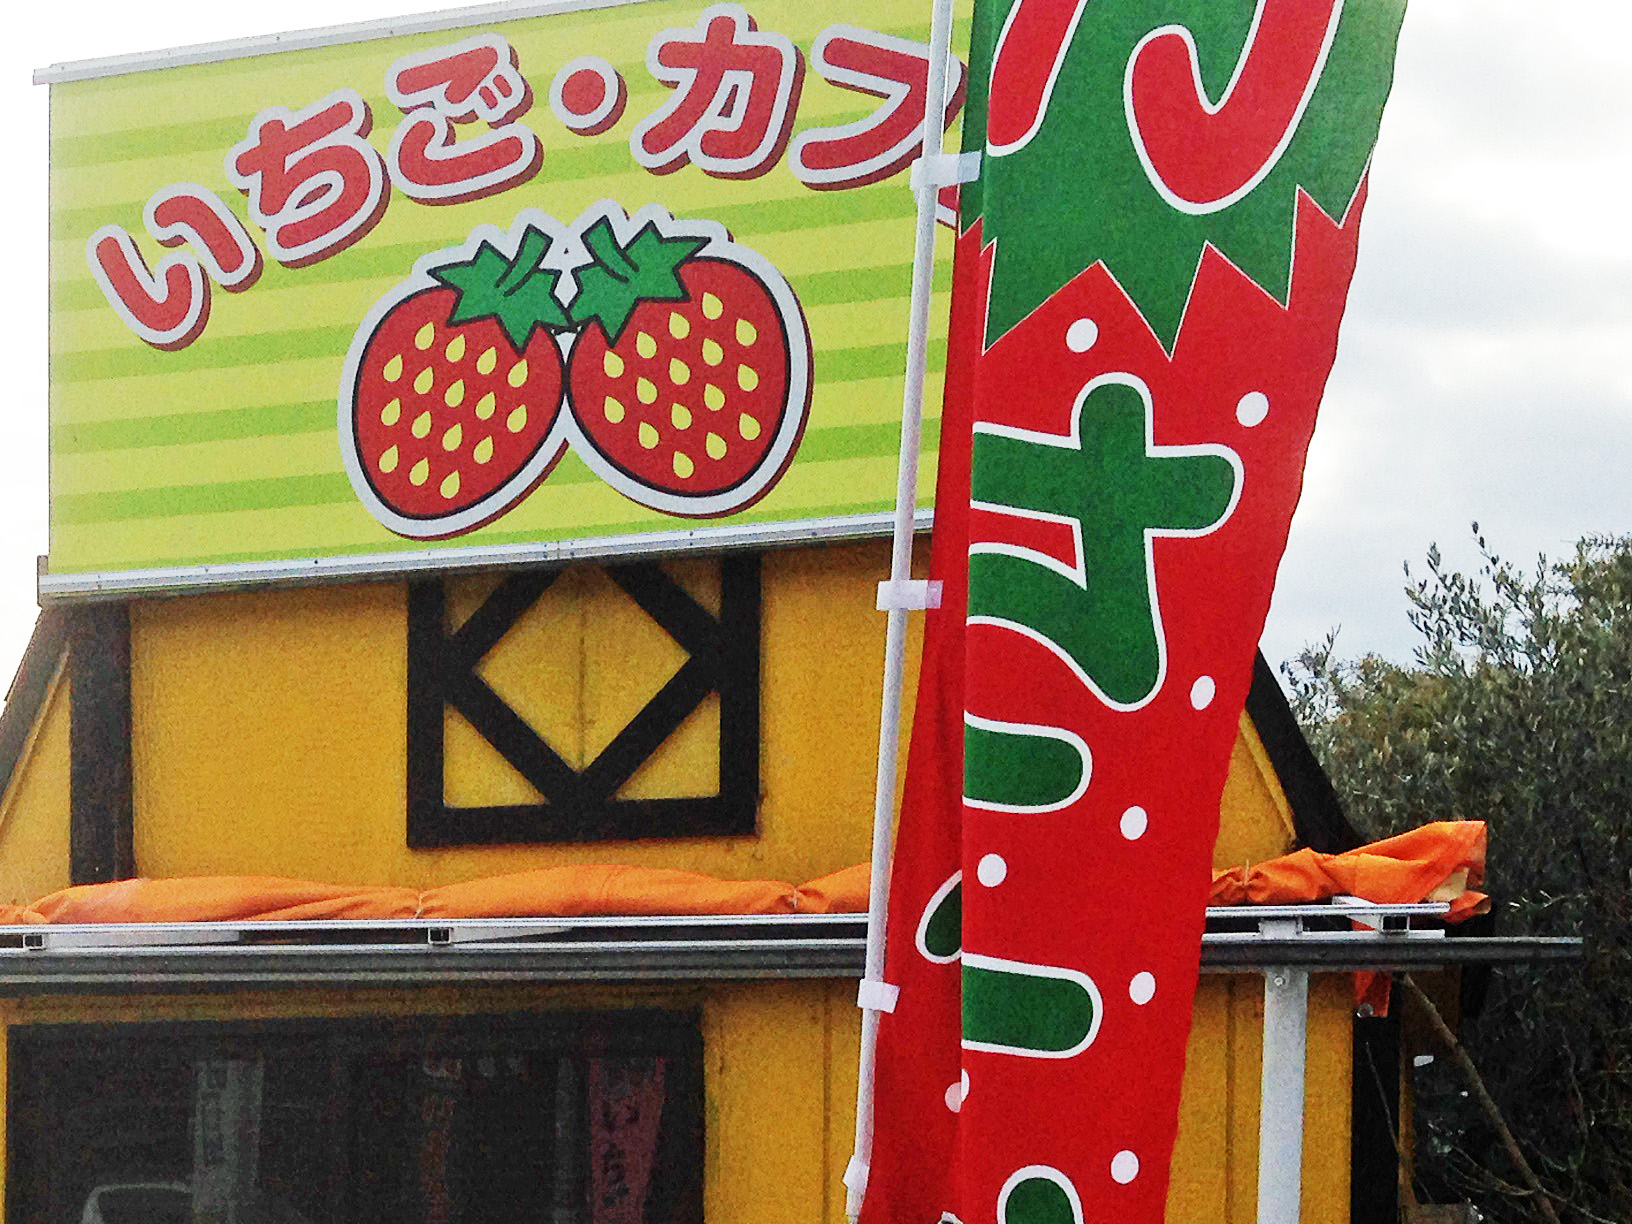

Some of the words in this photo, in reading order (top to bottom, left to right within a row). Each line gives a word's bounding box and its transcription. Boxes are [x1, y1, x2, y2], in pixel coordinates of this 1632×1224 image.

[88, 6, 967, 348] いちご・カフ
